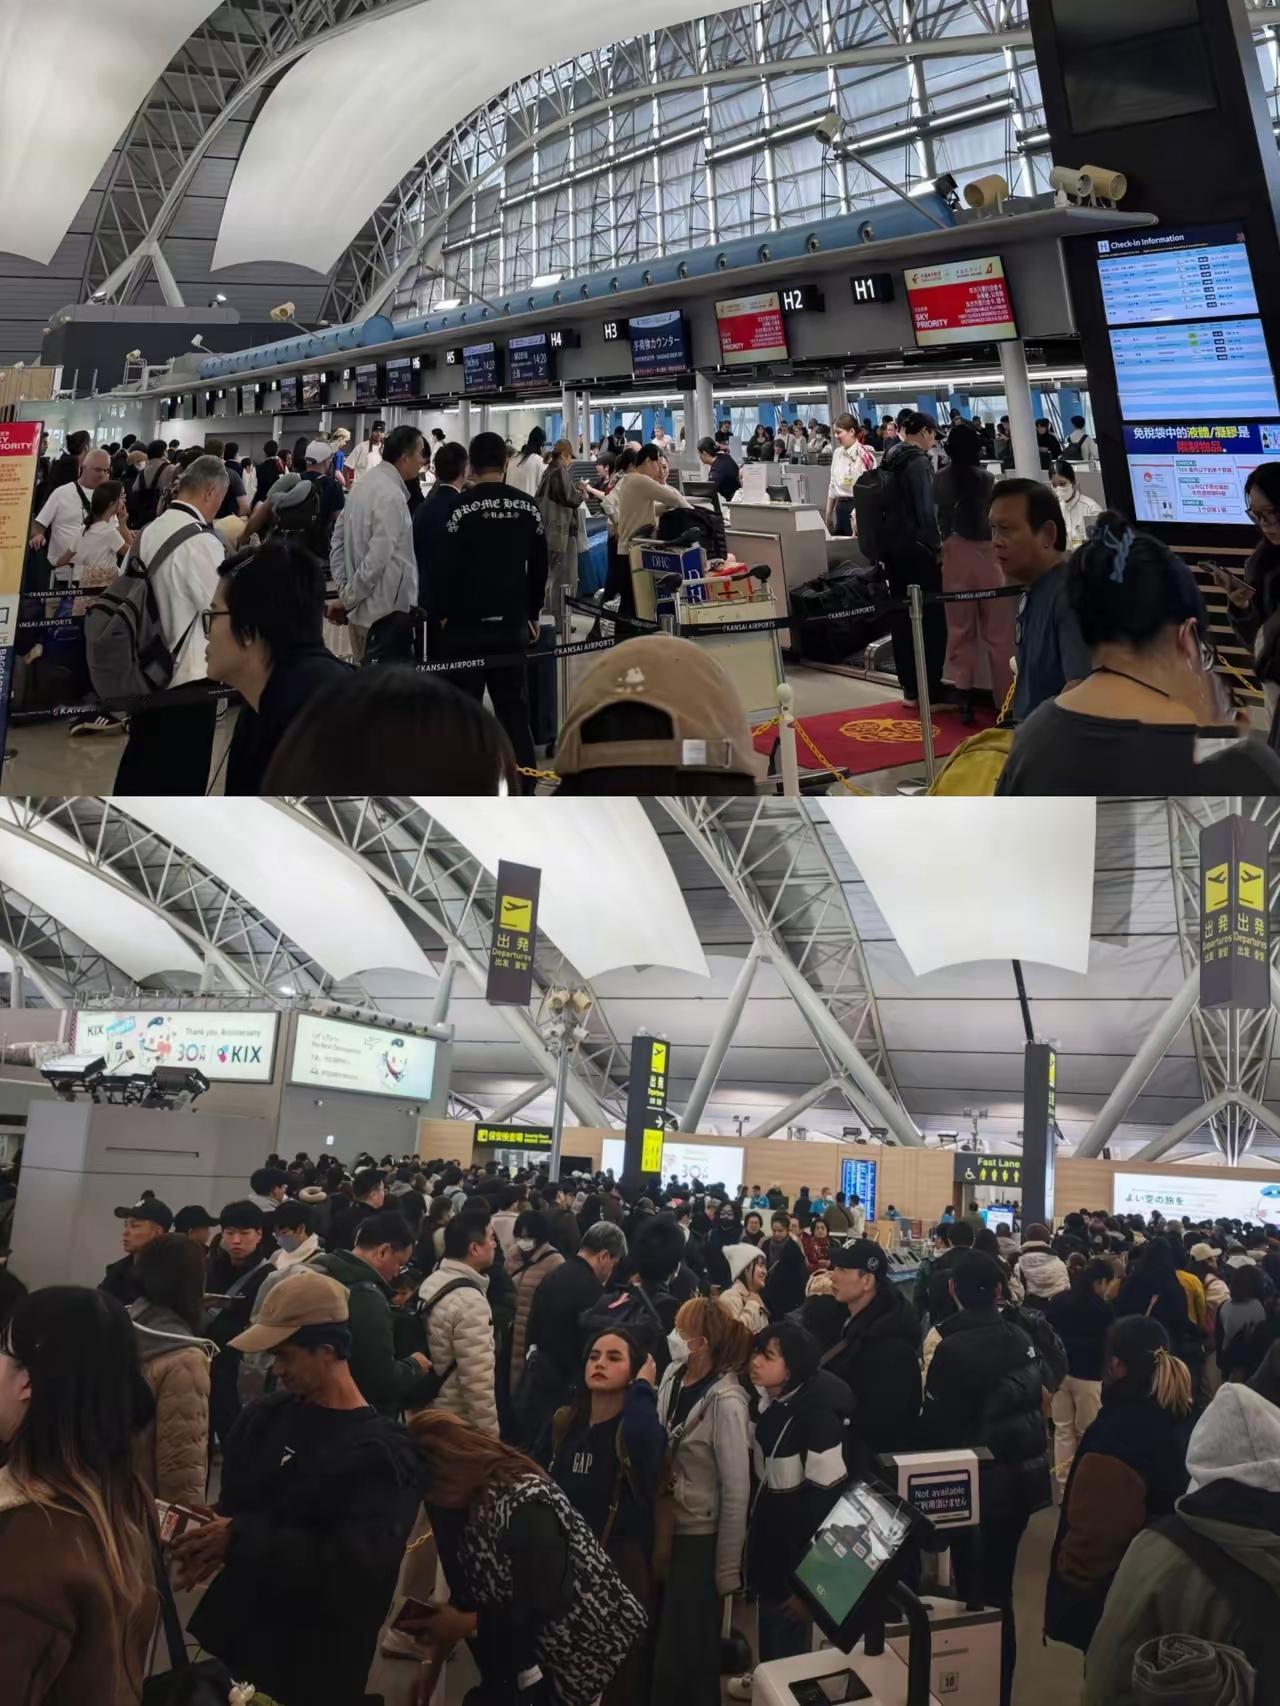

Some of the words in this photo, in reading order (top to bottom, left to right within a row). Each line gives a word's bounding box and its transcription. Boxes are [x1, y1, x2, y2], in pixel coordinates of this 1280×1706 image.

[1110, 238, 1141, 249] Check-in
[1141, 234, 1185, 245] Information
[854, 278, 876, 300] H1
[783, 290, 803, 310] H2
[604, 322, 618, 339] H3
[916, 319, 948, 328] PRIORITY
[550, 332, 562, 347] H4
[446, 351, 455, 364] H5
[726, 622, 747, 632] KANSAI
[558, 645, 583, 656] KANSAI
[584, 638, 615, 651] AIRPORTS
[420, 664, 448, 672] KANSAI
[450, 658, 485, 670] AIRPORTS
[1237, 912, 1265, 937] 出発
[497, 933, 529, 952] 出発
[231, 1045, 263, 1064] KIX
[977, 1156, 996, 1167] Fast
[998, 1158, 1021, 1168] Lane
[572, 1452, 593, 1474] GAP
[914, 1489, 930, 1498] Not
[931, 1485, 966, 1497] available
